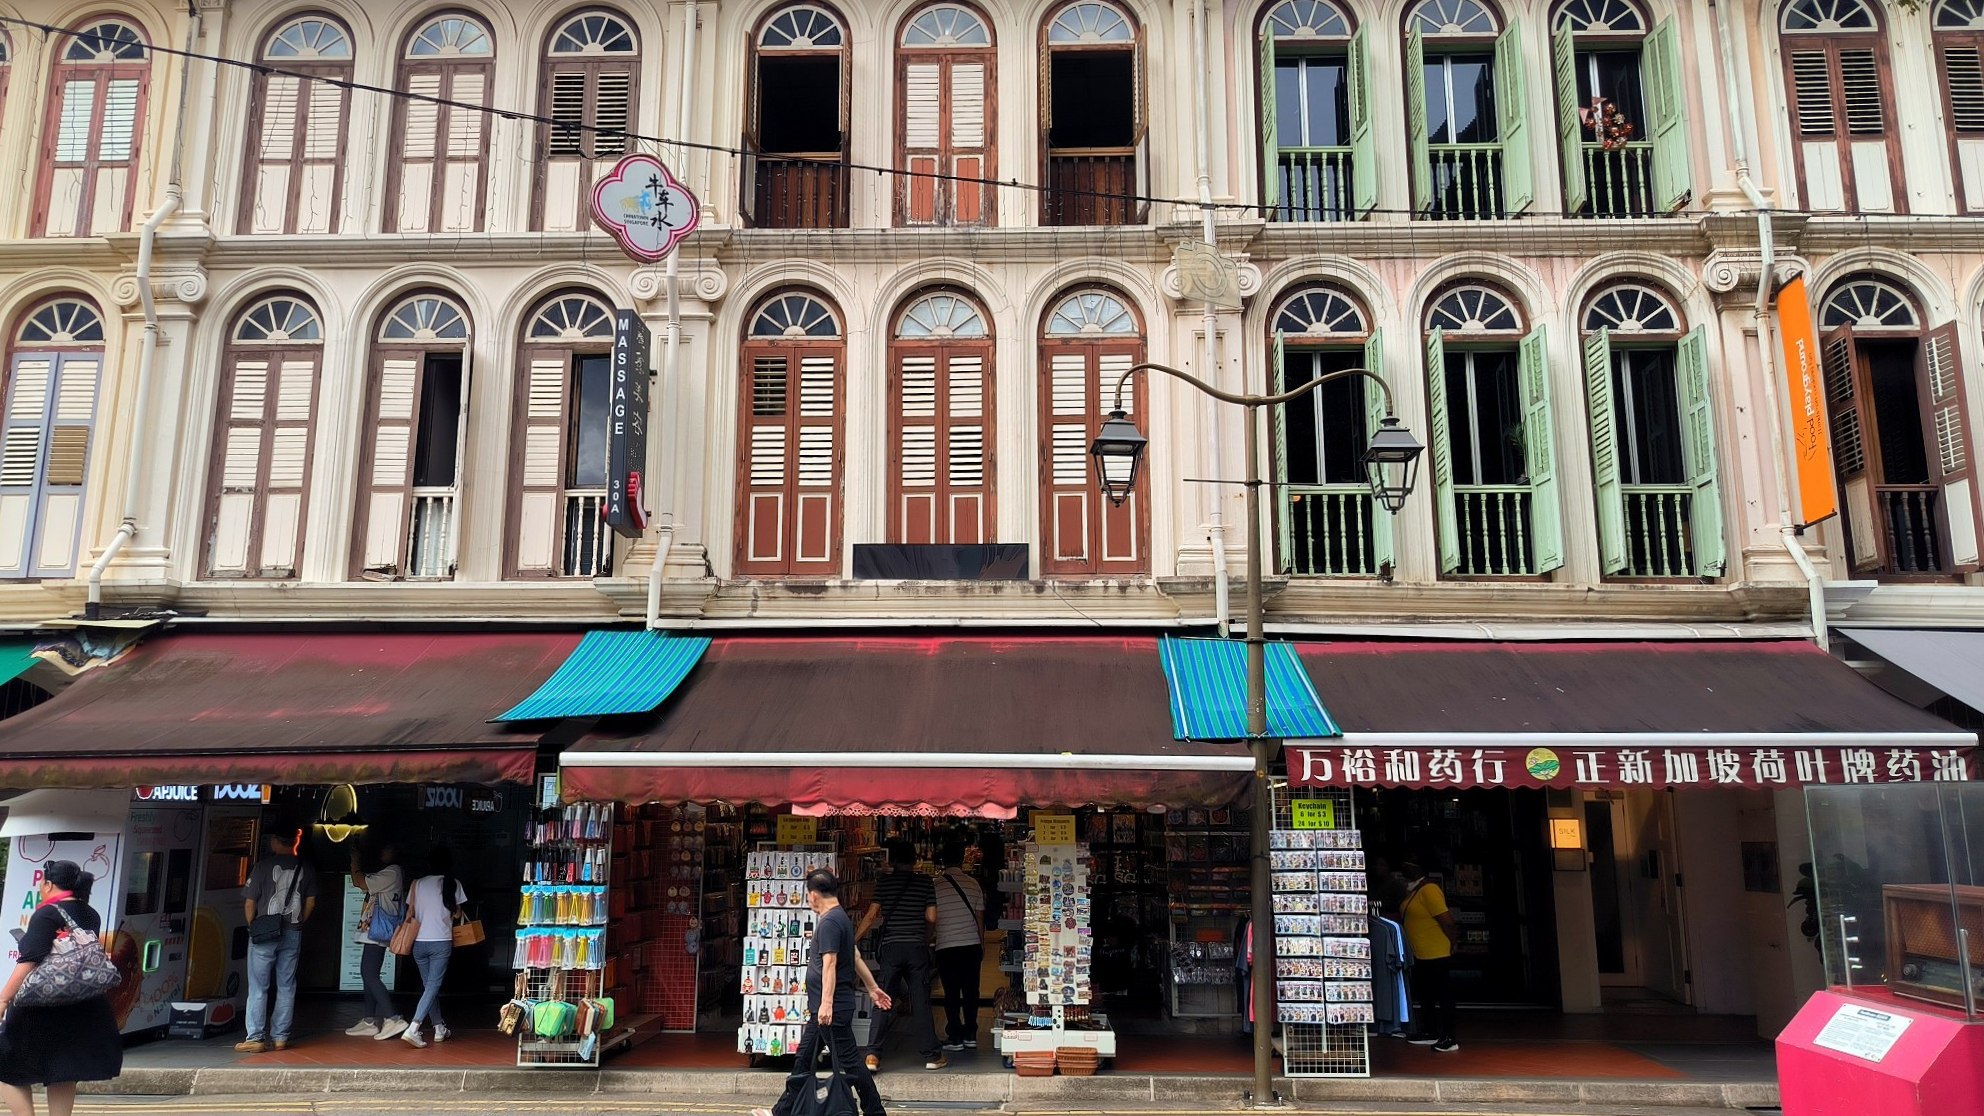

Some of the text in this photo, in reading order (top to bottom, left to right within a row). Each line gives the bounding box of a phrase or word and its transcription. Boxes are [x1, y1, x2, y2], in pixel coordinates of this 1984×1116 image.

[645, 173, 674, 231] 牛车水
[611, 318, 629, 513] MASSAGE 30A
[1795, 337, 1818, 450] food playground
[1296, 749, 1507, 783] 万裕和药行
[1572, 749, 1968, 784] 正新加坡荷叶牌药油
[1298, 802, 1326, 810] Keychain
